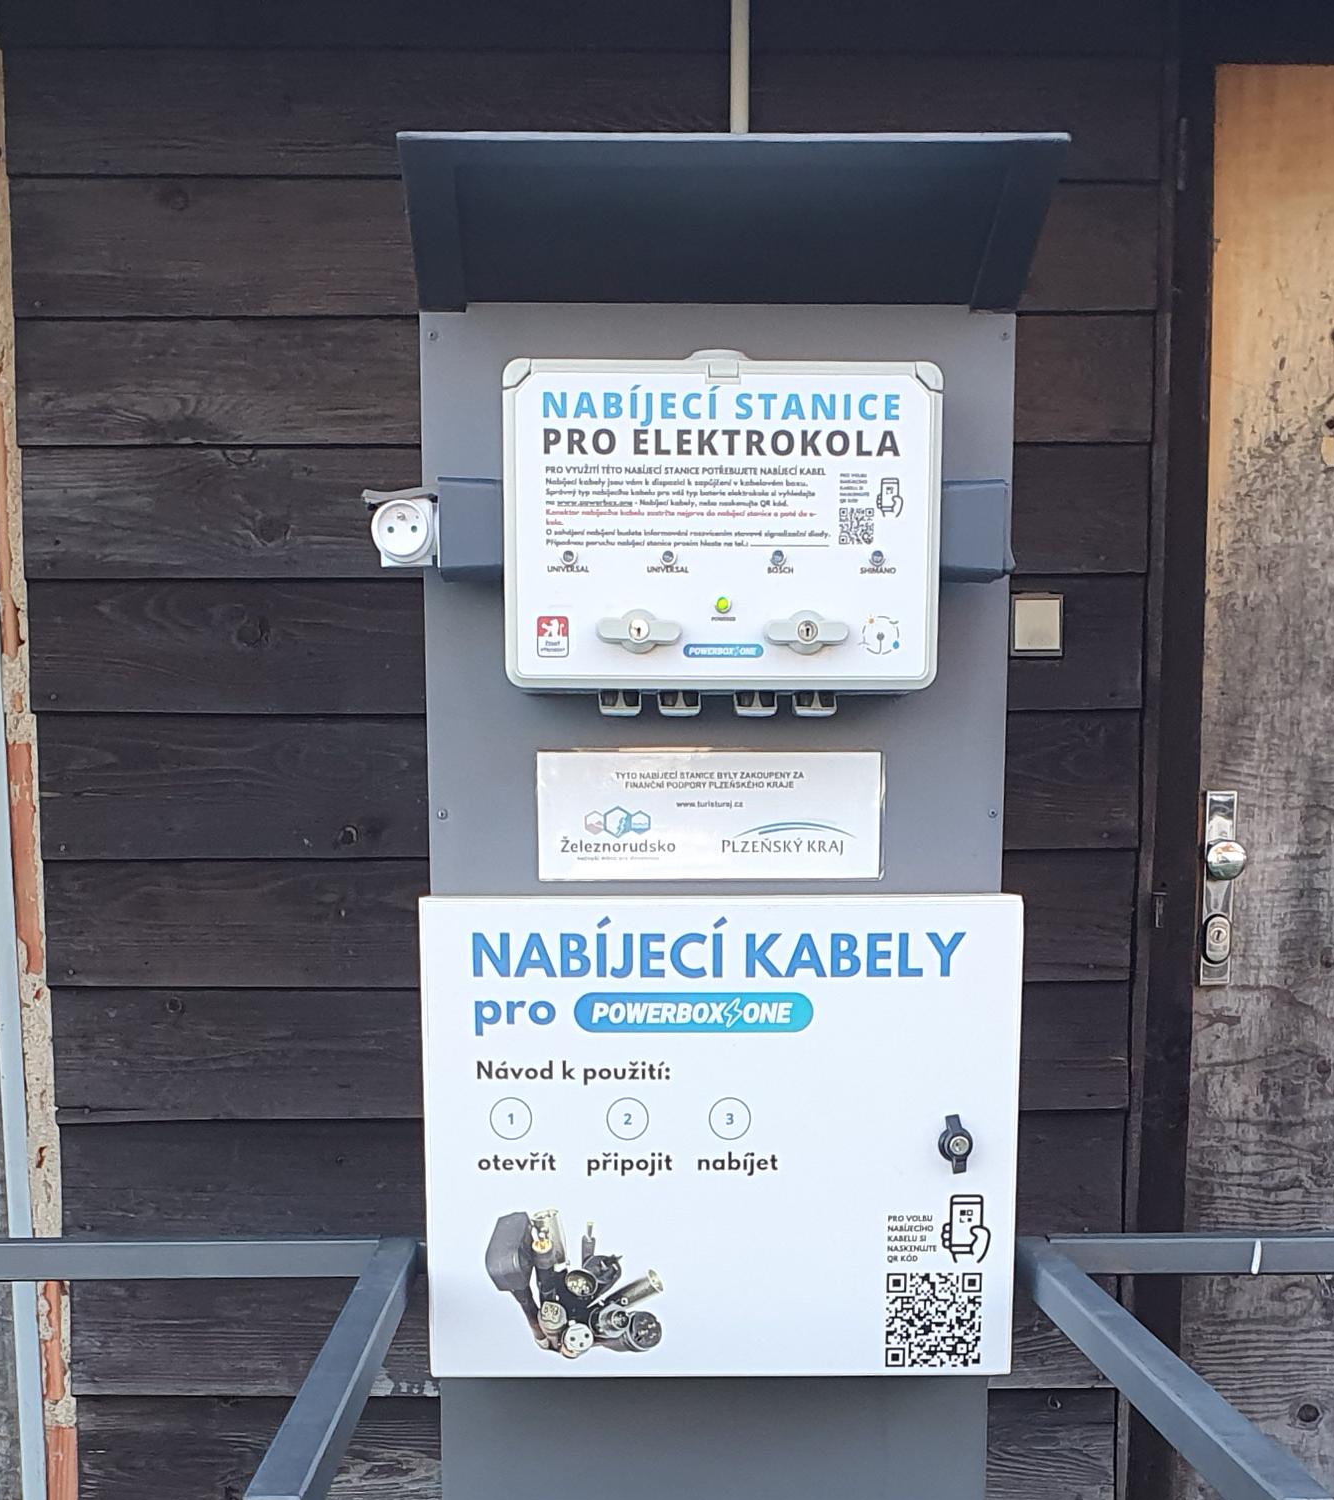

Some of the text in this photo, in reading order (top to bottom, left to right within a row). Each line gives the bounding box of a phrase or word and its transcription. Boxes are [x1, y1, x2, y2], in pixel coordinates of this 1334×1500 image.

[542, 384, 901, 427] NABÍJECÍ STANICE
[542, 428, 902, 457] PRO ELEKTROKOLA
[545, 464, 826, 476] PRO VYUŽITÍ TÉTO NABÍJECÍ STANICE POTŘEBUJETE NABÍJECÍ KABEL
[547, 565, 589, 573] UNIVERSAL
[647, 565, 689, 573] UNIVERSAL
[767, 566, 793, 574] BOSCH
[860, 566, 896, 574] SHIMANO
[639, 770, 677, 779] NABÍJECÍ
[717, 772, 738, 780] BYLY
[740, 771, 791, 779] ZAKOUPENY
[793, 771, 804, 779] ZA
[625, 781, 664, 789] FINANČNÍ
[709, 780, 764, 789] PLZEŇSKÉHO
[560, 836, 676, 853] Železnorudsko
[722, 838, 843, 856] PLZEŇSKÝ KRAJ
[471, 916, 967, 979] NABÍJECÍ KABELY
[474, 1000, 793, 1036] pro POWERBOX ONE
[477, 1060, 670, 1086] Návod k použití:
[507, 1112, 514, 1126] 1
[623, 1112, 633, 1126] 2
[725, 1112, 735, 1126] 3
[477, 1152, 557, 1172] otevřít
[586, 1152, 674, 1177] připojit
[697, 1151, 779, 1177] nabíjet
[887, 1223, 934, 1232] NABÍJECÍHO
[887, 1254, 918, 1263] QR KÓD
